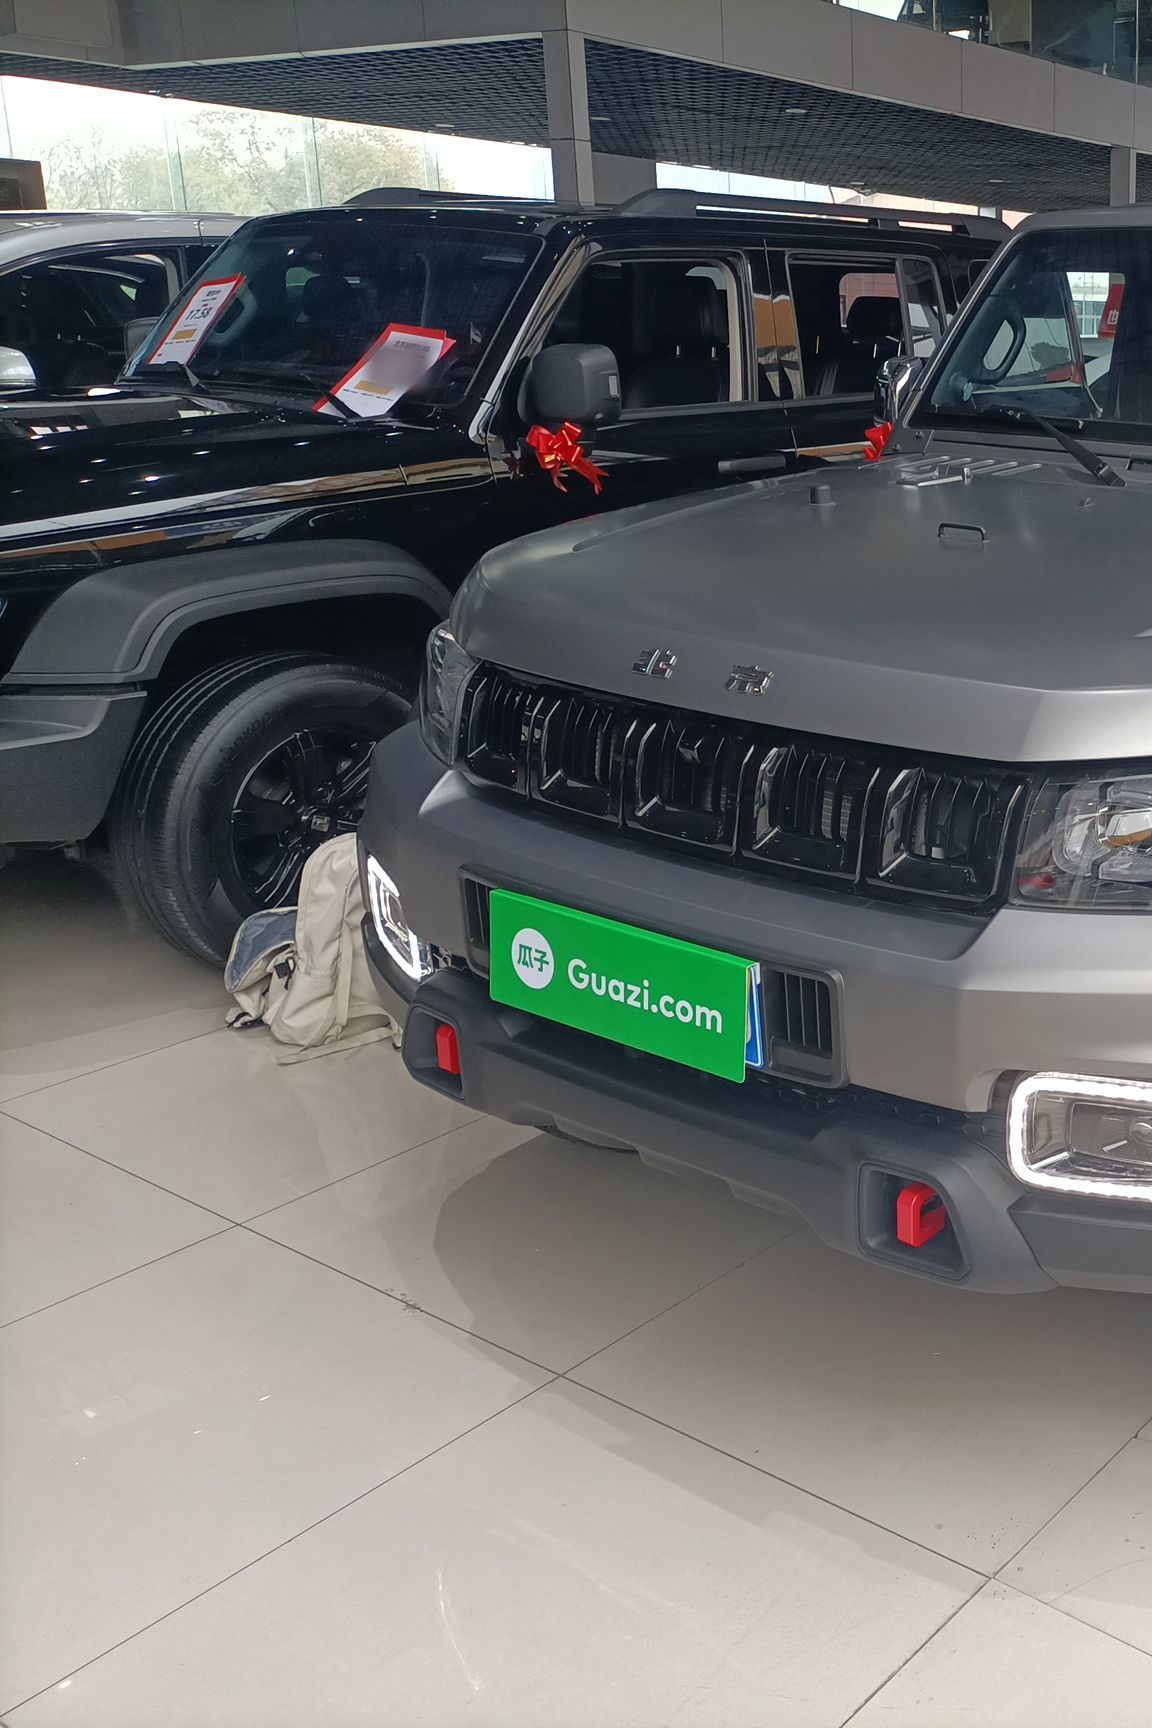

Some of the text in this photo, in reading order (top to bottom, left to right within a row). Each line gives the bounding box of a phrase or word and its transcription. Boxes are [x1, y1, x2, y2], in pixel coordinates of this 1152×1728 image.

[632, 649, 774, 696] 北京
[516, 943, 550, 973] 瓜子
[567, 958, 723, 1034] Guazi.com
